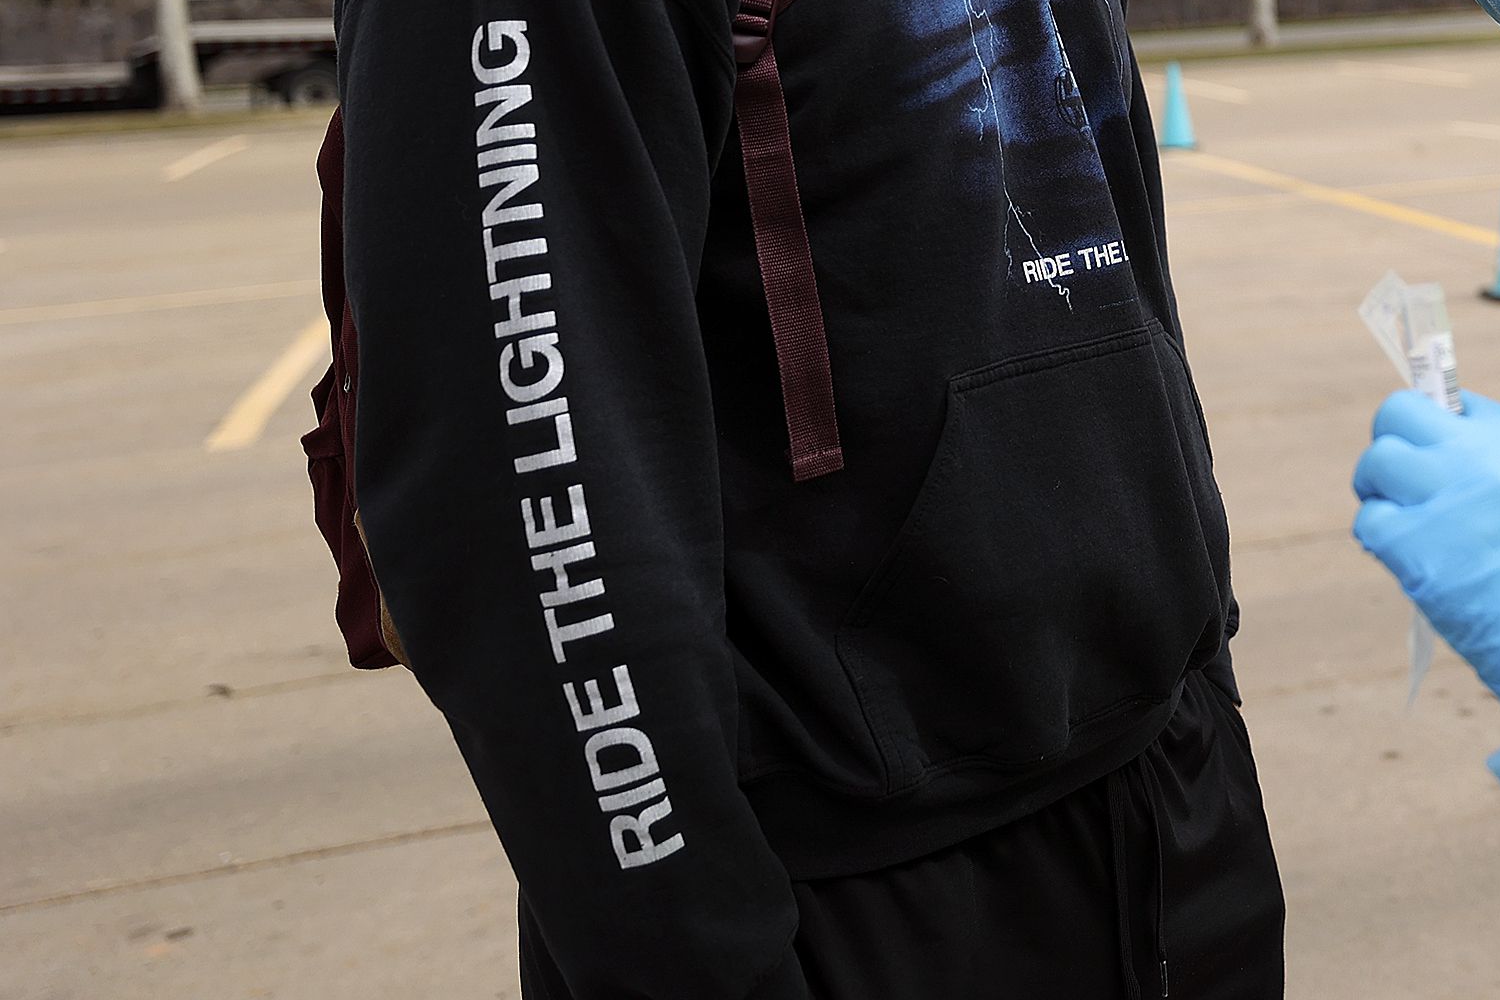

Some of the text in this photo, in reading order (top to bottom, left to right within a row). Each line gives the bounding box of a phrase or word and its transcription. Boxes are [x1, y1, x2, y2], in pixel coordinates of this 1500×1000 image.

[471, 19, 685, 870] RIDE THE LIGHTNING
[1022, 253, 1075, 284] RIDE
[1077, 241, 1123, 270] THE
